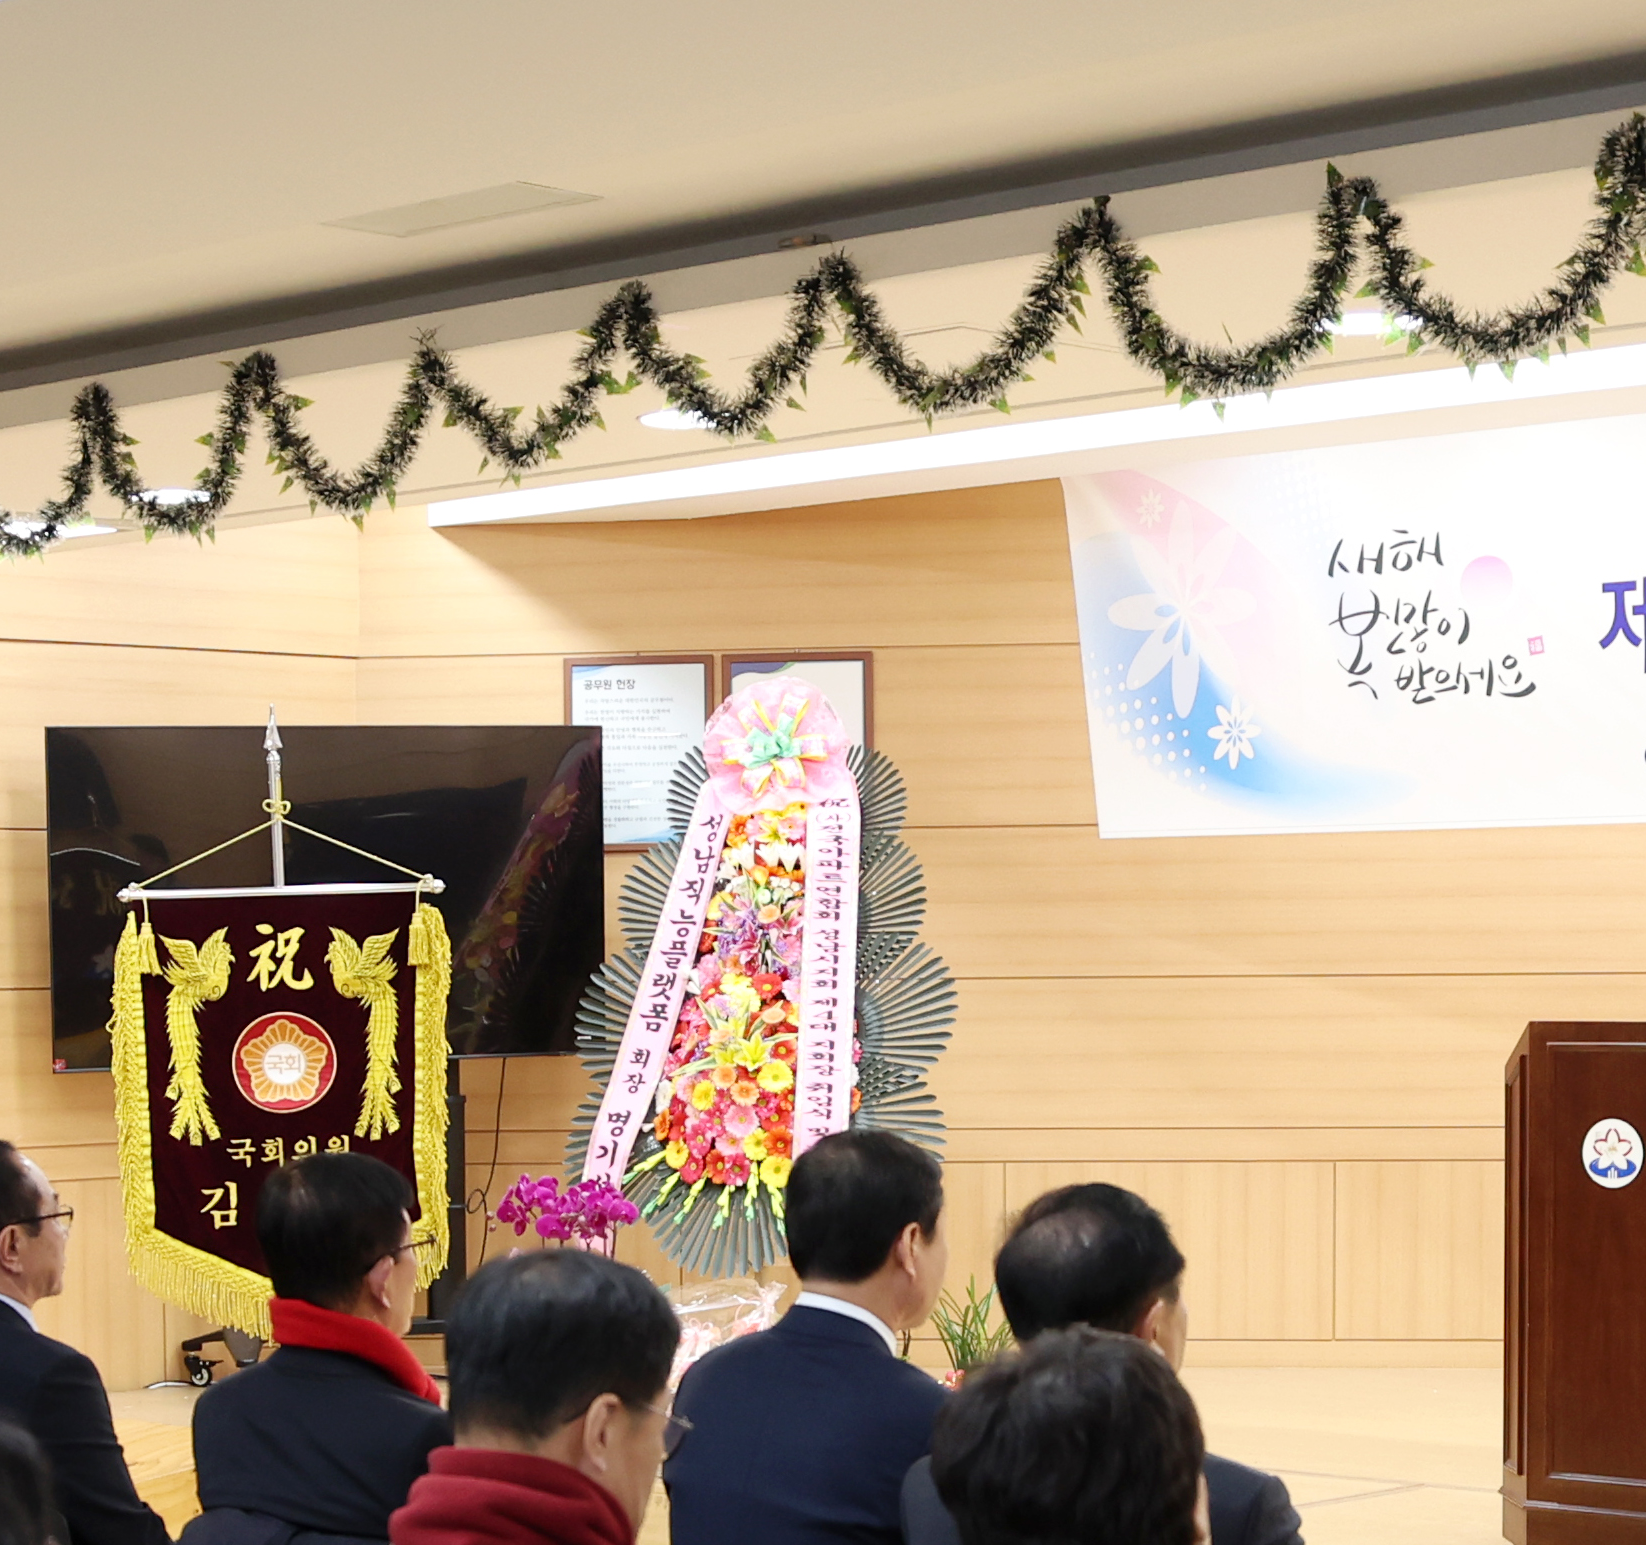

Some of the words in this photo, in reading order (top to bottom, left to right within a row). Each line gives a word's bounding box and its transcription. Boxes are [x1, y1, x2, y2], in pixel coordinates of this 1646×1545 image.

[1327, 529, 1445, 578] 새해
[1328, 589, 1390, 700] 복
[1386, 589, 1471, 655] 많이
[583, 679, 612, 690] 공무원
[1393, 654, 1537, 705] 받으세요
[639, 813, 725, 1033] 성남직능플랫폼
[246, 923, 315, 992] 祝
[266, 1053, 302, 1075] 국회
[621, 1048, 651, 1094] 회장
[200, 1181, 238, 1230] 김
